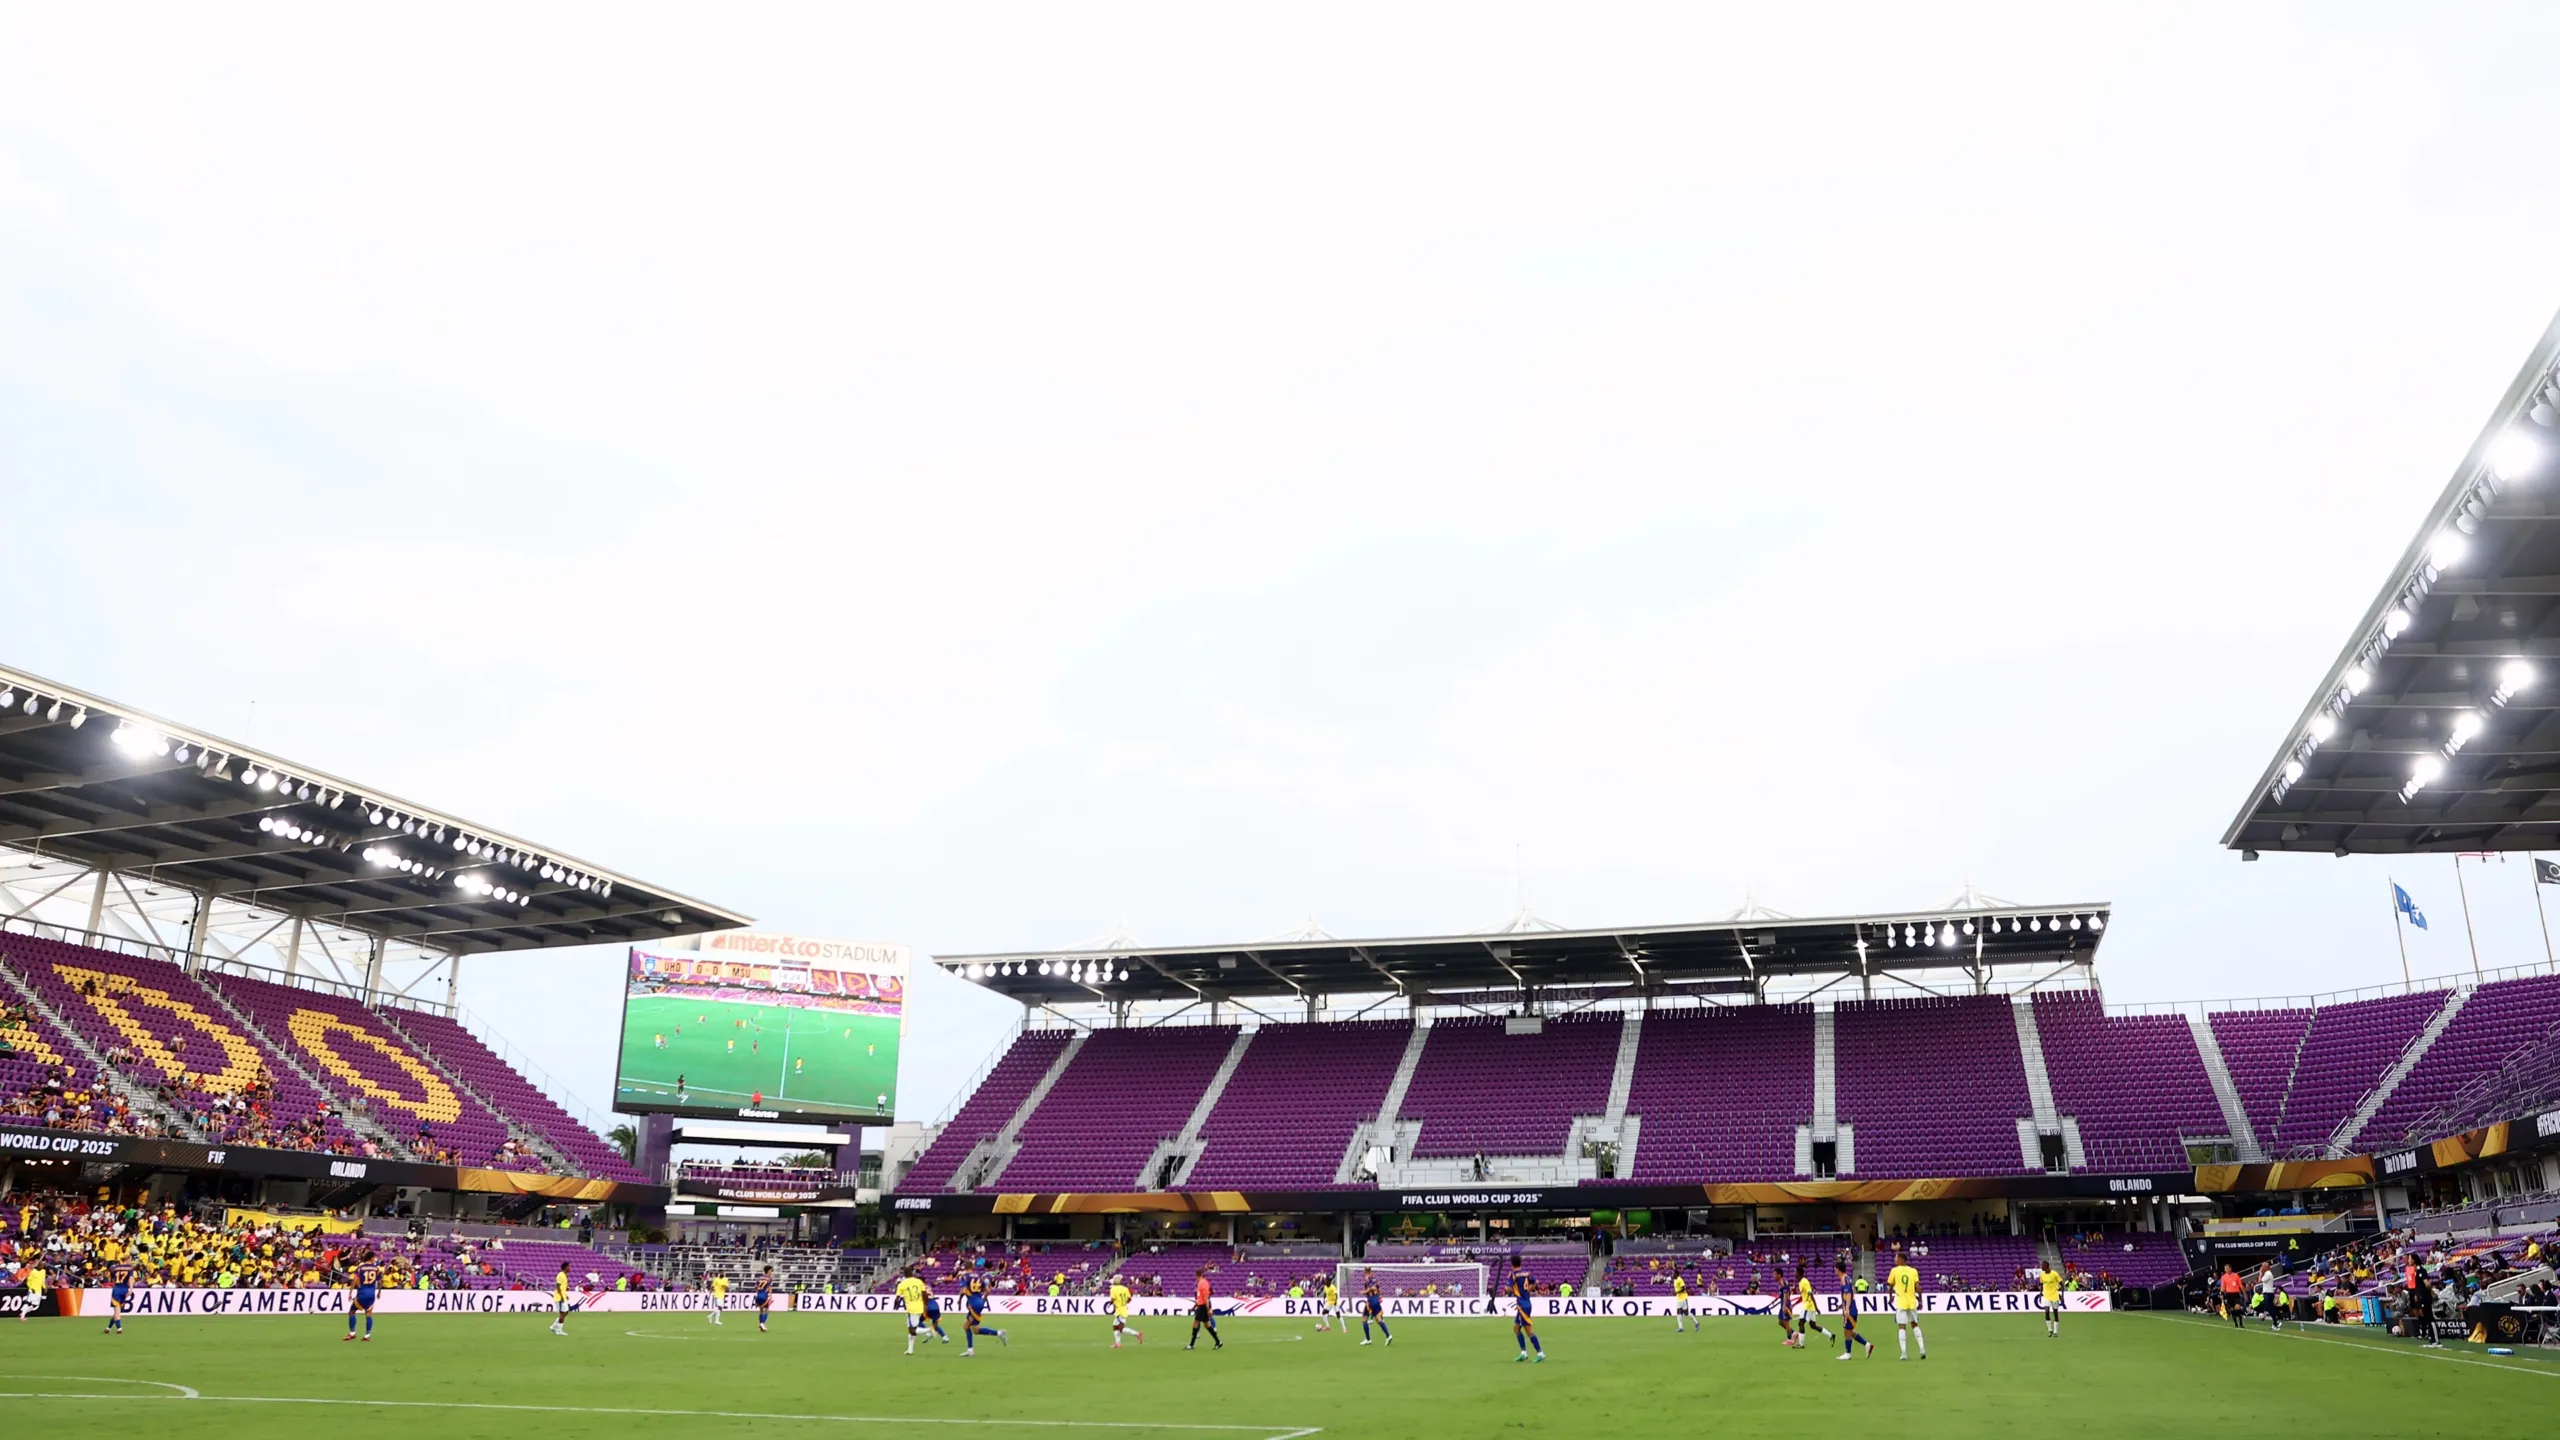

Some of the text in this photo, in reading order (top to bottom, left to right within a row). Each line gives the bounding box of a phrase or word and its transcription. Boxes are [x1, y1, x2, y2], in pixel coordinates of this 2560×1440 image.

[823, 943, 898, 966] STADIUM
[664, 961, 681, 973] UHD
[731, 967, 751, 979] MSU
[1462, 991, 1526, 1005] LEGENDS
[738, 1107, 780, 1119] Hisense
[0, 1133, 51, 1151] WORLD
[52, 1138, 80, 1153] CUP
[329, 1161, 367, 1179] ORLANDO
[2109, 1178, 2152, 1192] ORLANDO
[718, 1189, 734, 1197] FIFA
[735, 1190, 754, 1198] CLUB
[755, 1191, 782, 1199] WORLD
[782, 1191, 798, 1200] CUP
[1402, 1195, 1424, 1205] FIFA
[1425, 1195, 1450, 1205] CLUB
[1452, 1194, 1489, 1204] WORLD
[1490, 1194, 1511, 1204] CUP
[894, 1197, 932, 1210] #FIFACWC
[1481, 1246, 1511, 1255] STADIUM
[115, 1270, 128, 1284] 17
[363, 1270, 376, 1284] 19
[1901, 1274, 1909, 1293] 9
[906, 1285, 920, 1301] 13
[121, 1291, 344, 1313] BANK OF AMERICA
[425, 1292, 476, 1311] BANK
[482, 1295, 505, 1313] OF
[641, 1294, 678, 1310] BANK
[682, 1294, 699, 1310] OF
[802, 1295, 857, 1311] BANK
[864, 1296, 891, 1311] OF
[1036, 1298, 1096, 1313] BANK
[1549, 1299, 1614, 1315] BANK
[1623, 1300, 1653, 1316] OF
[1827, 1296, 1895, 1313] BNK
